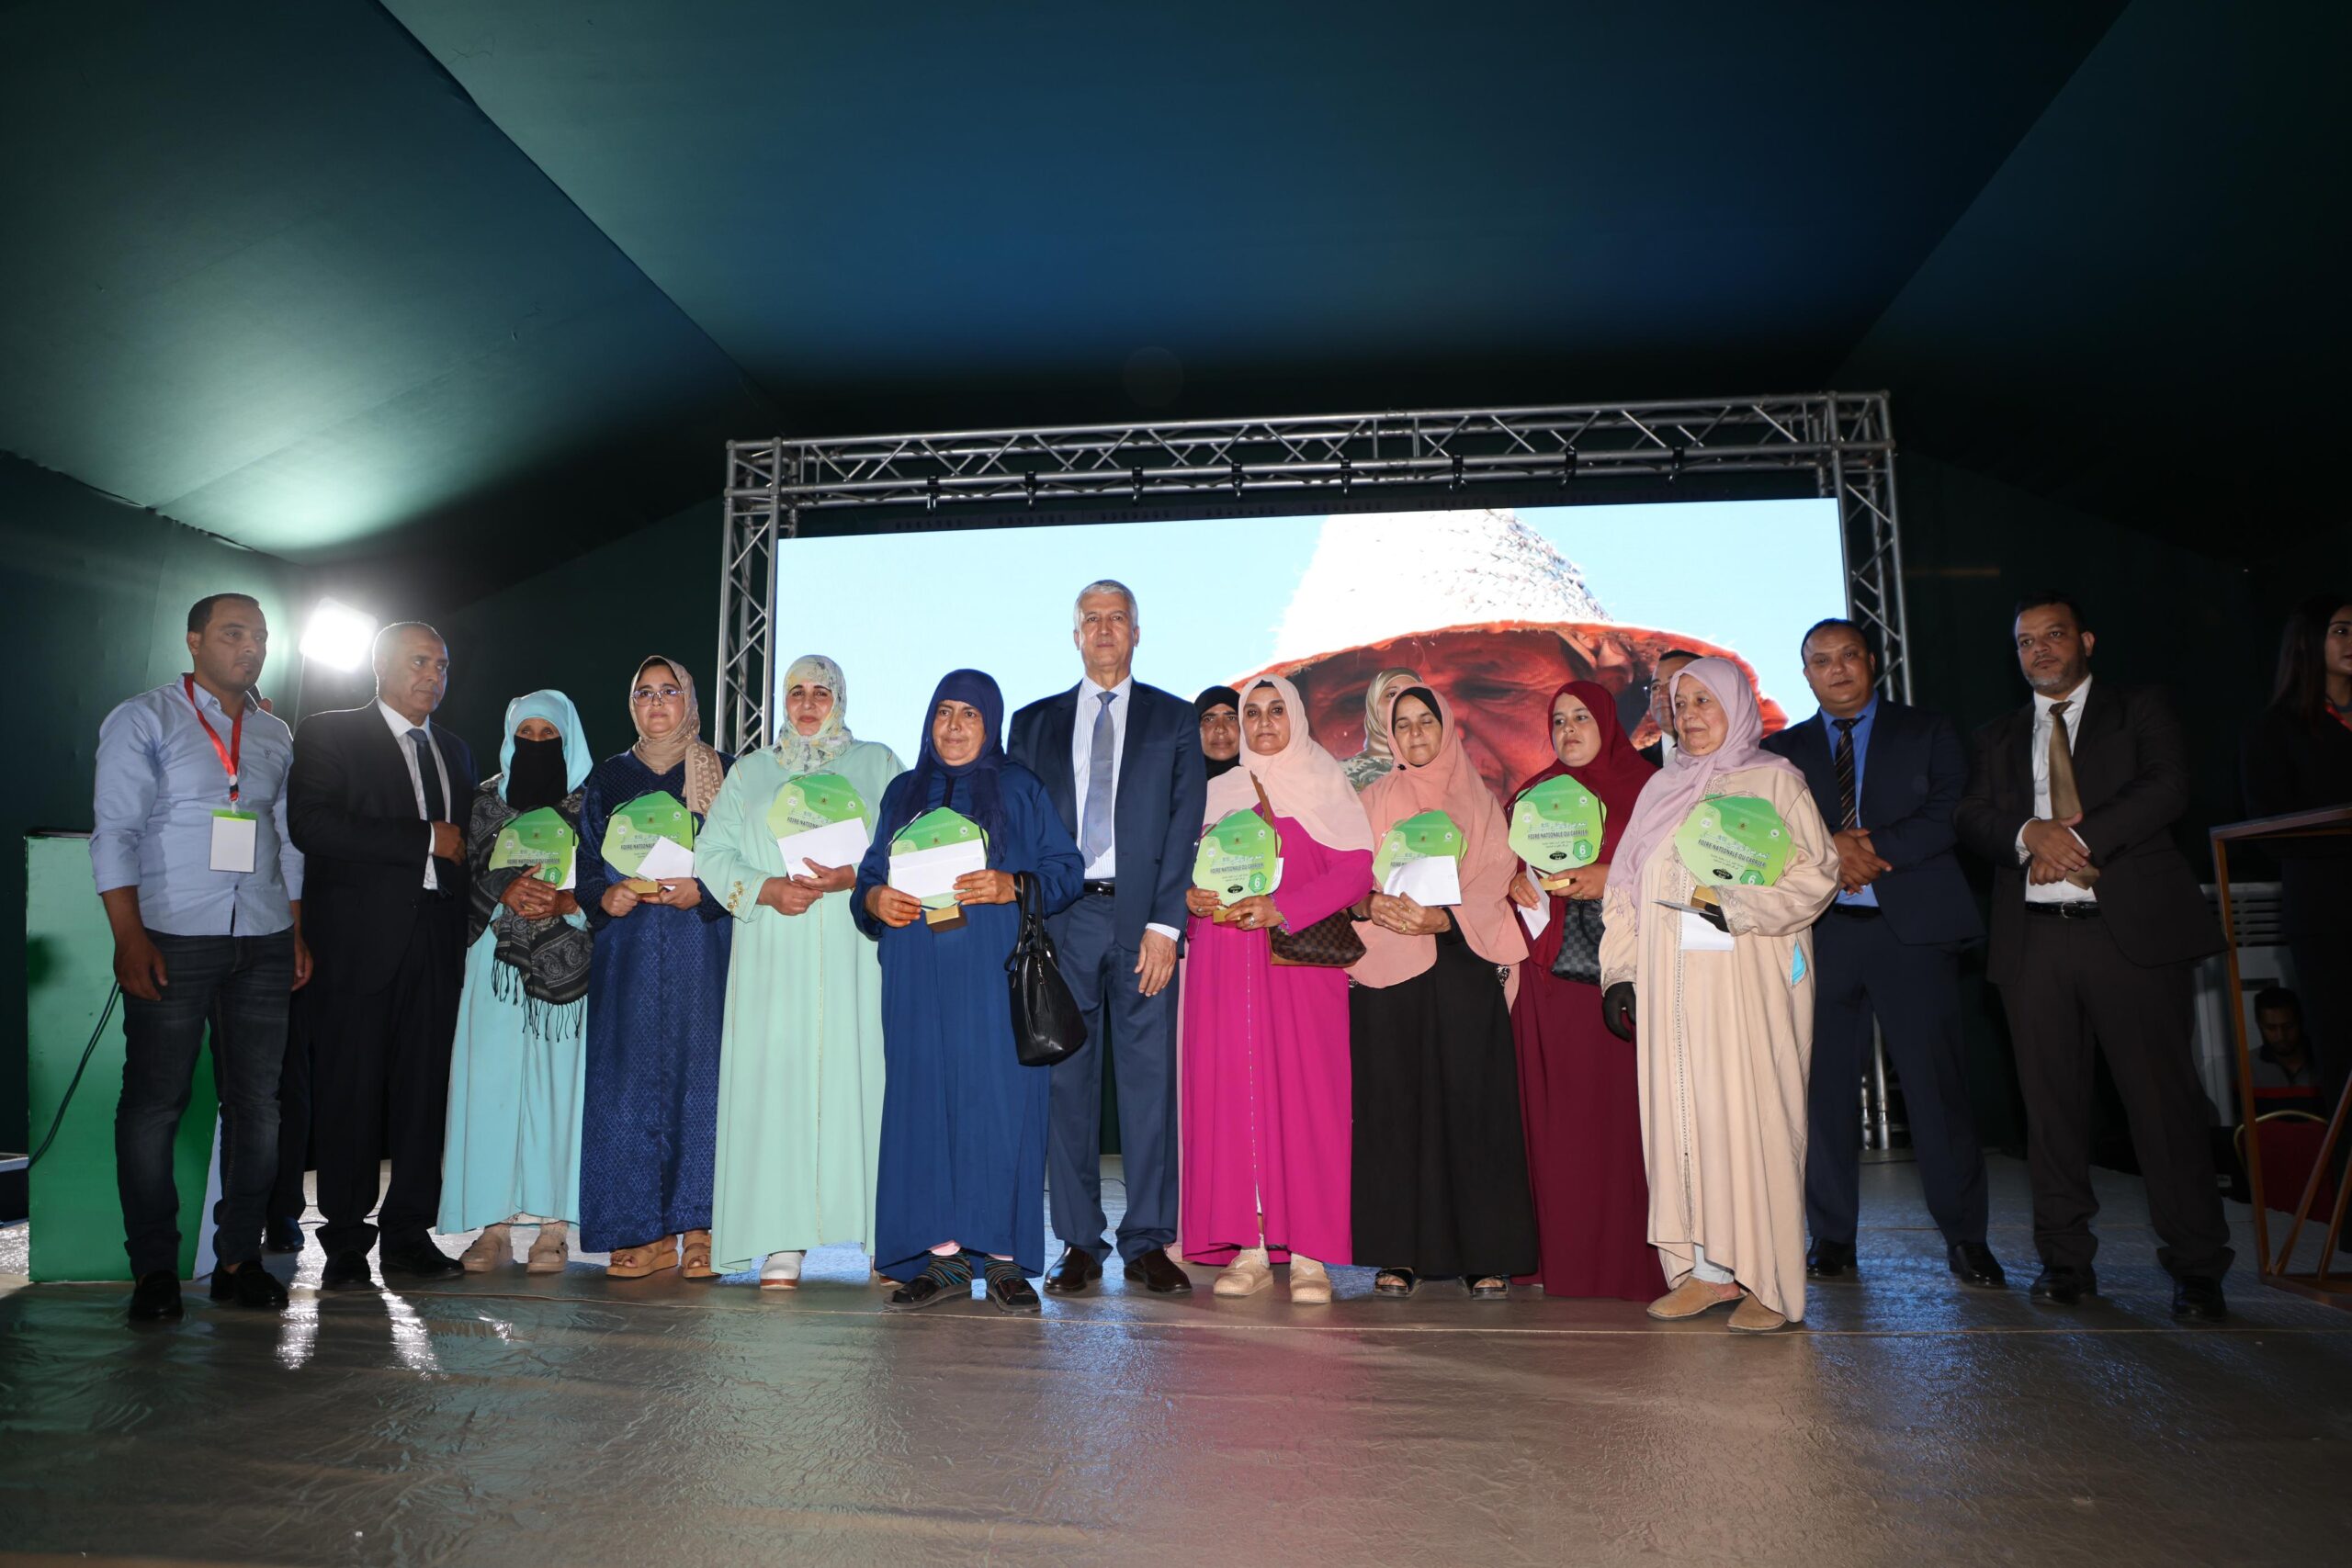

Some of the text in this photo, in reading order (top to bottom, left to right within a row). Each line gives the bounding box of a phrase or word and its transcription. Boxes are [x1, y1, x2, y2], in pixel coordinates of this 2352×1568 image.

[1579, 844, 1586, 855] 6
[1698, 839, 1713, 849] FOIRE
[1713, 844, 1737, 858] NATIONALE
[1254, 877, 1260, 888] 6
